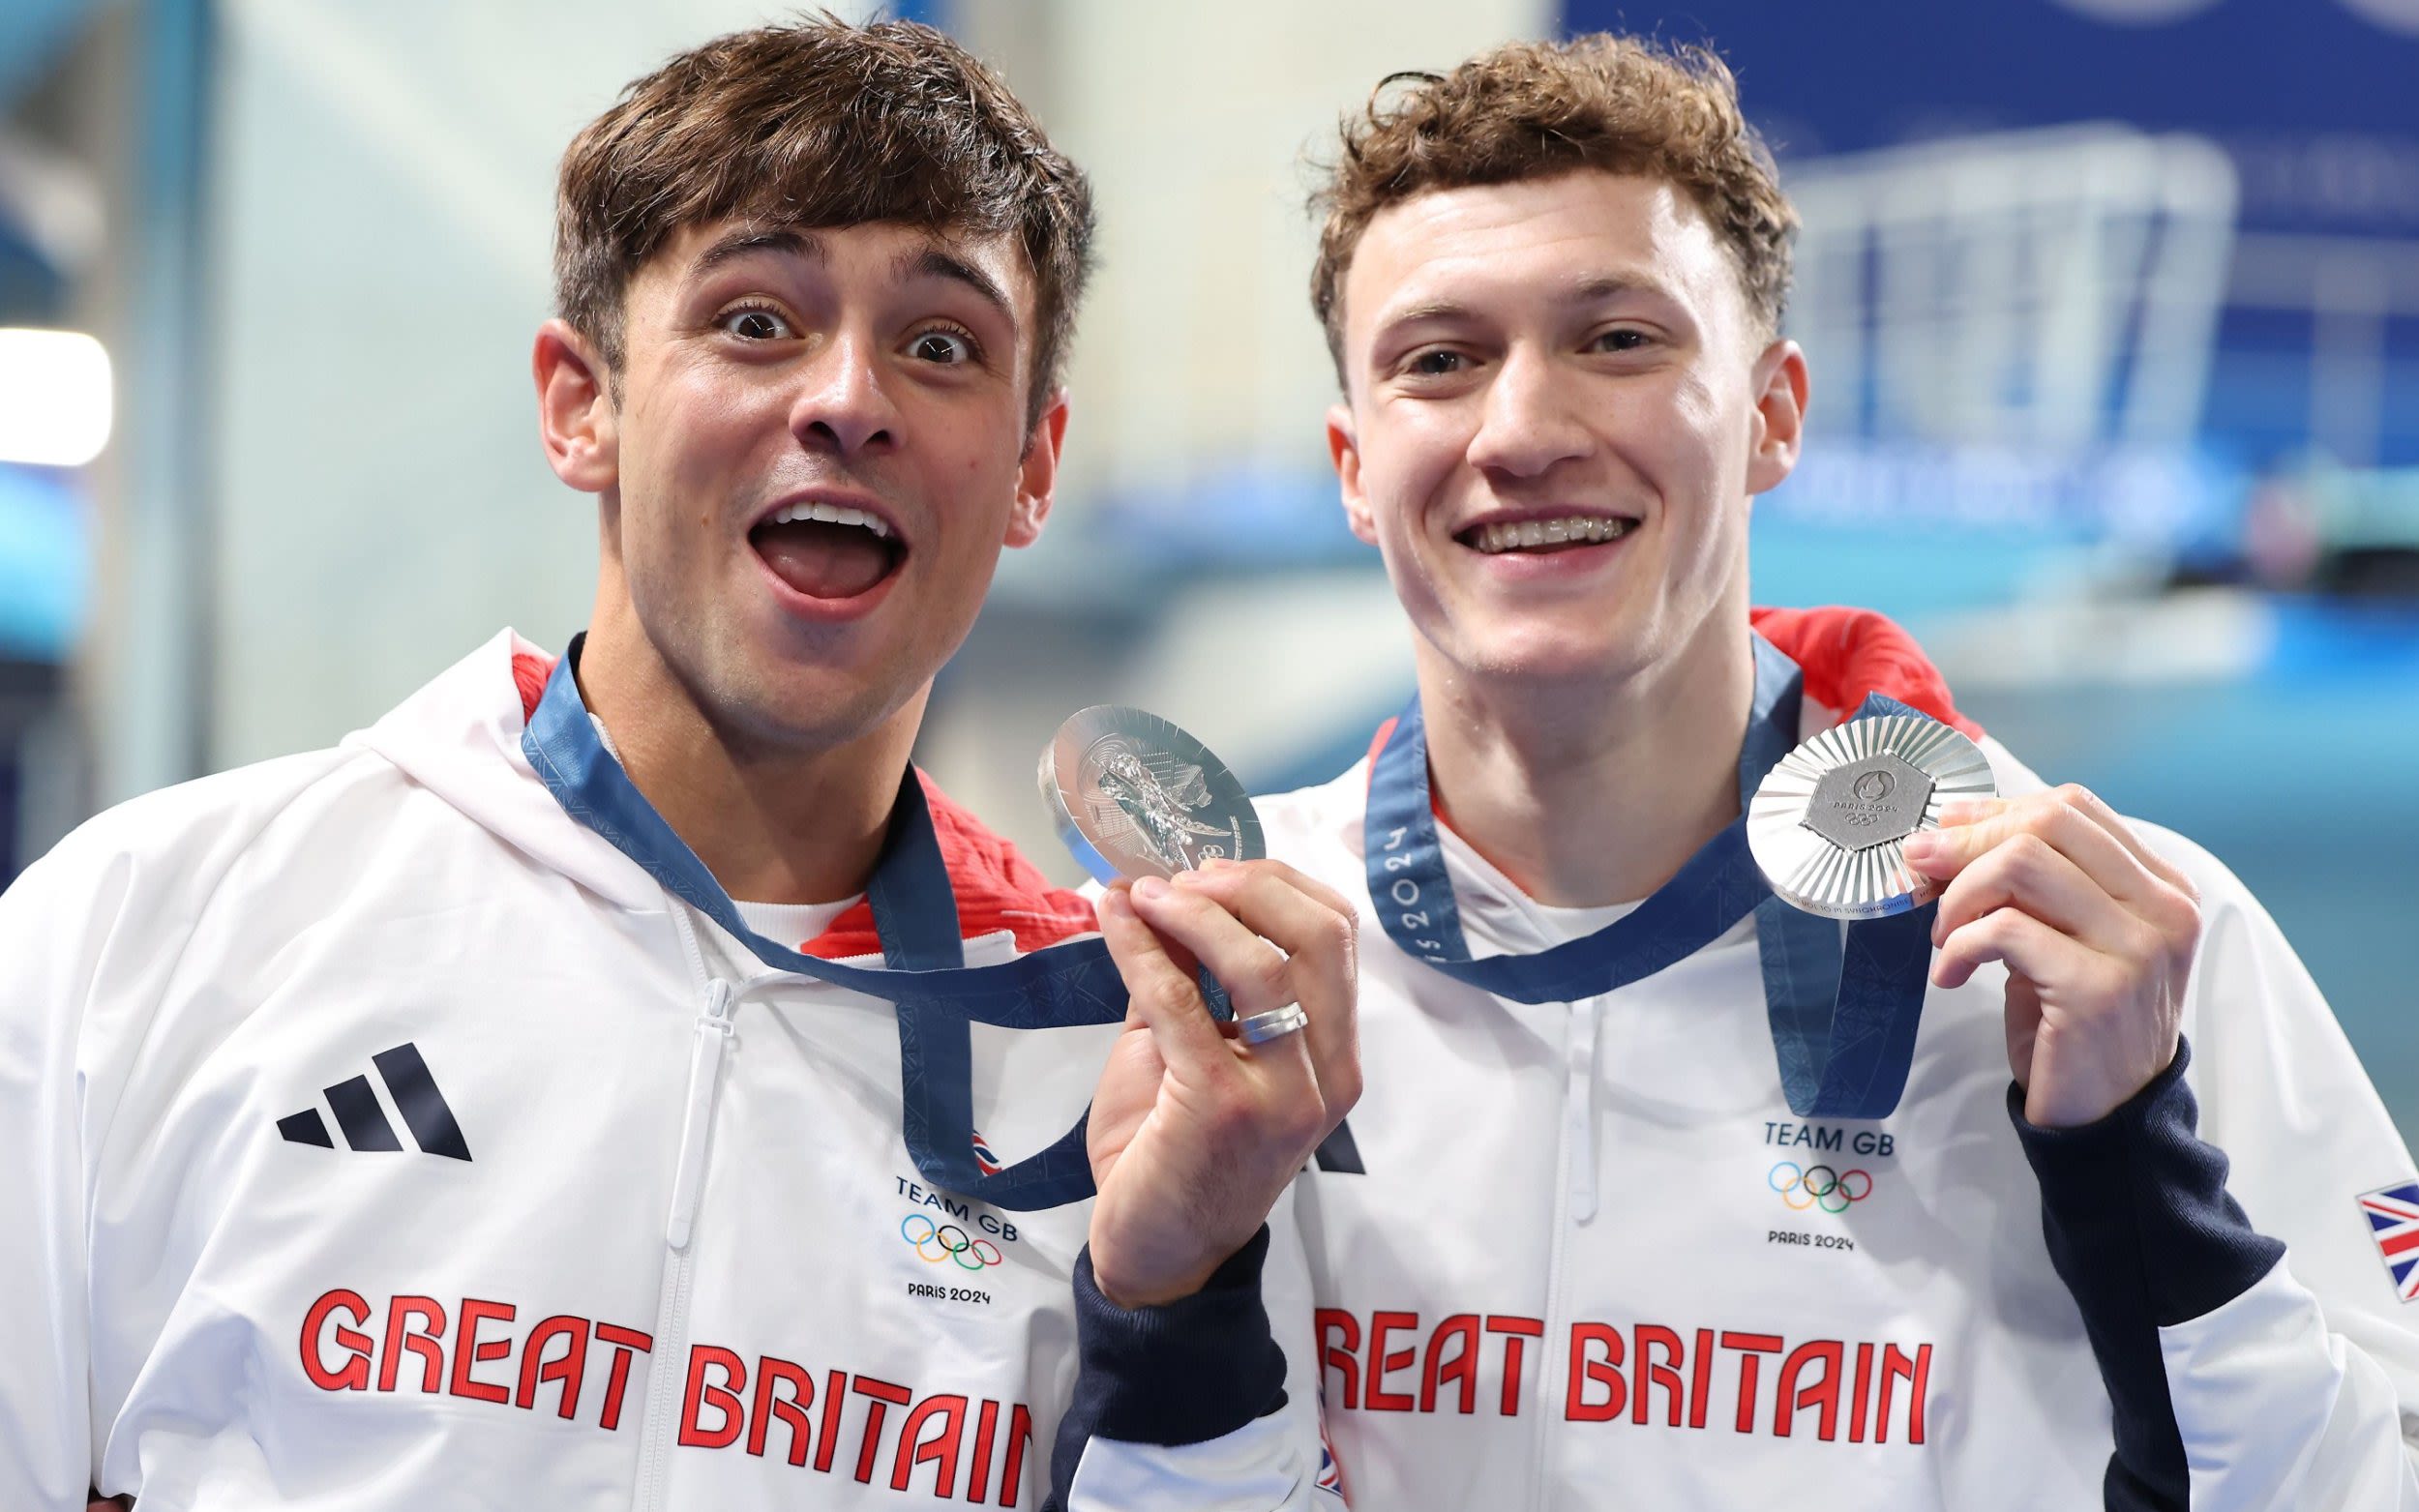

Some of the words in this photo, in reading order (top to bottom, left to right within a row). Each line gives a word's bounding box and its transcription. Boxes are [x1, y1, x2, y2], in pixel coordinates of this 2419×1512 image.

[1384, 826, 1430, 930] 2024
[1765, 1122, 1843, 1152] TEAM
[1853, 1131, 1895, 1157] GB
[896, 1175, 970, 1221] TEAM
[978, 1214, 1018, 1242] GB
[1814, 1234, 1855, 1251] 2024
[949, 1288, 991, 1304] 2024
[300, 1289, 653, 1431] GREAT
[1315, 1308, 1543, 1416] REAT
[1565, 1322, 1933, 1444] BRITAIN
